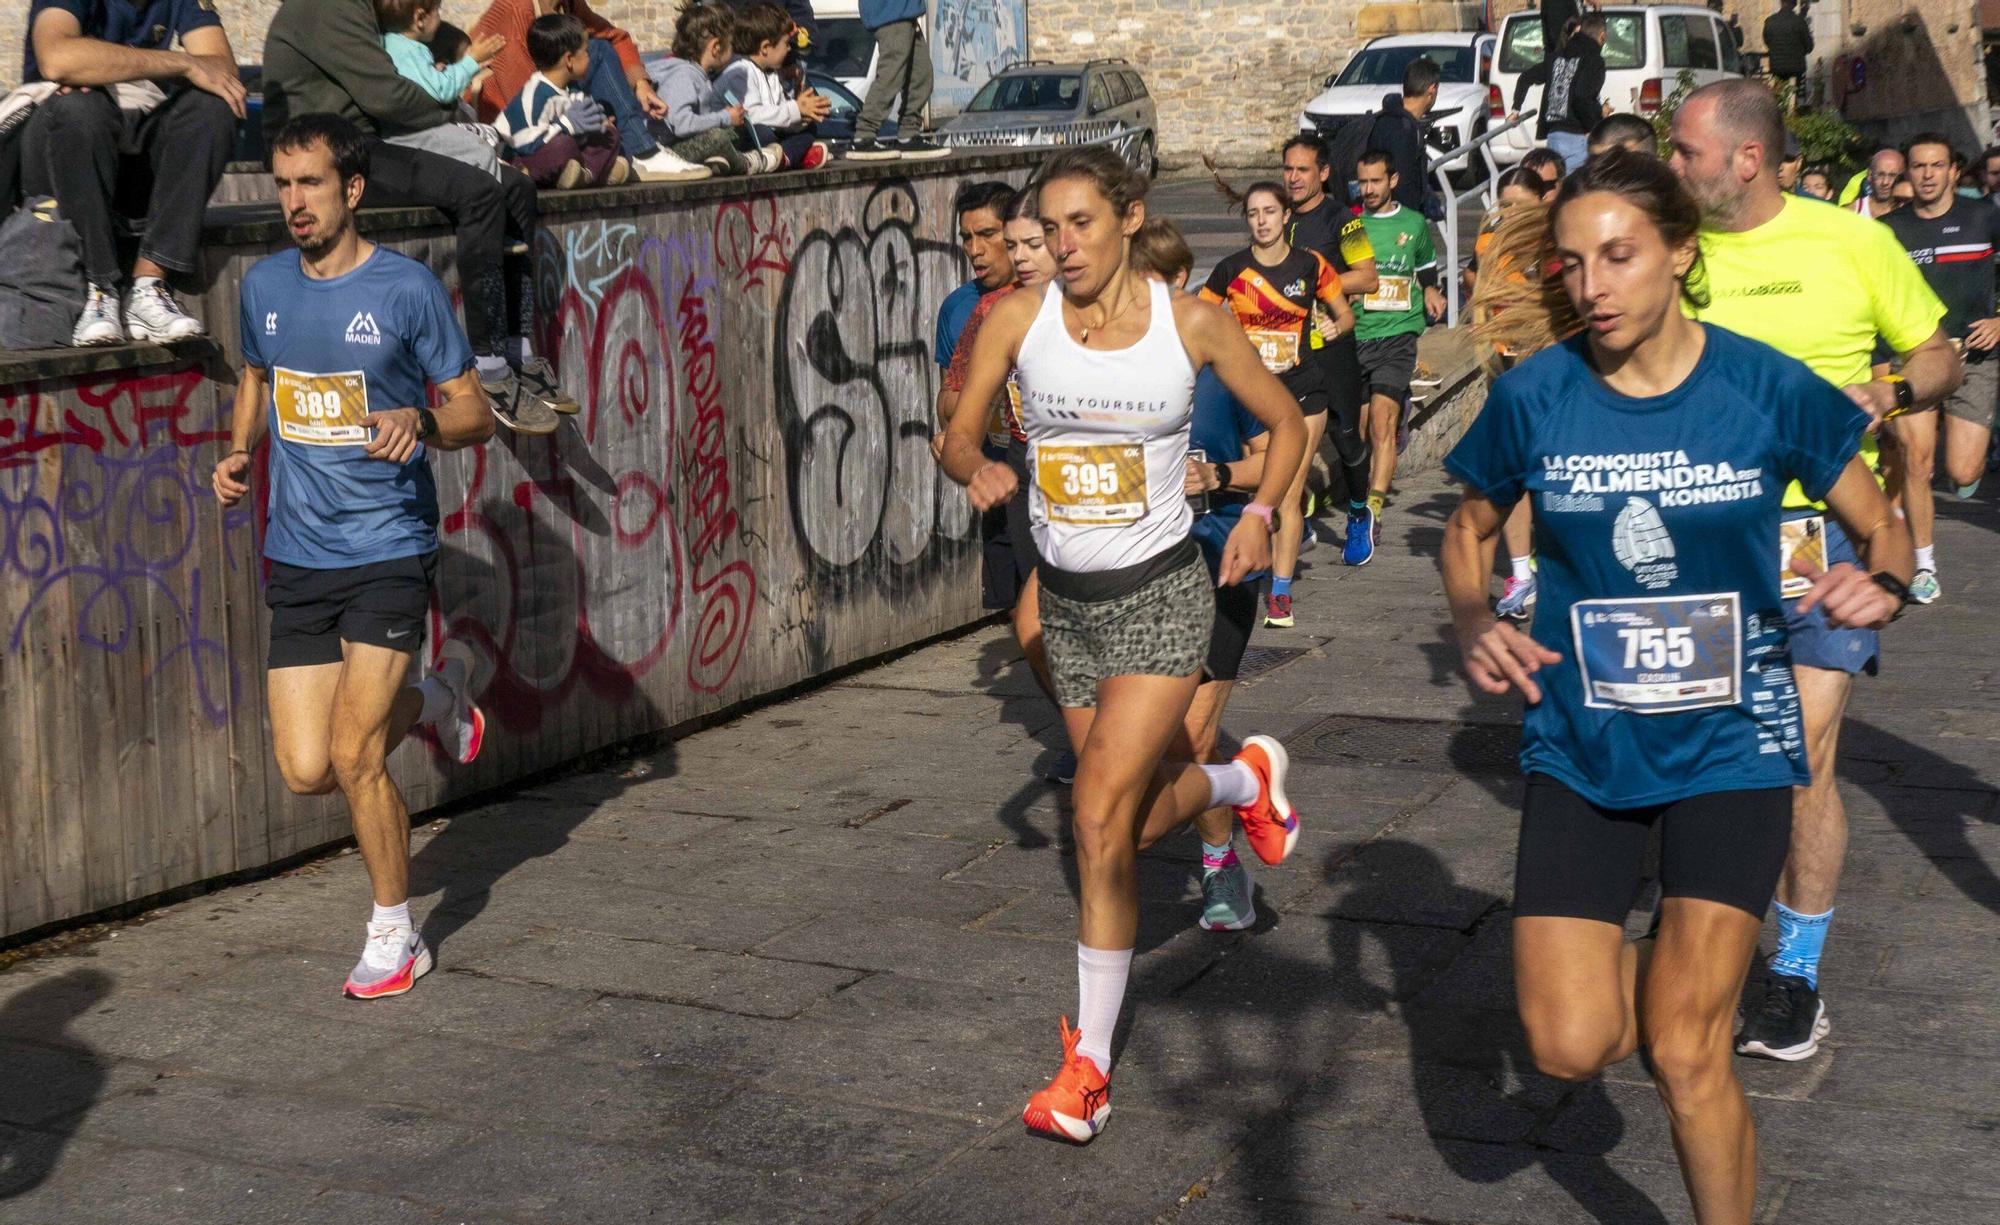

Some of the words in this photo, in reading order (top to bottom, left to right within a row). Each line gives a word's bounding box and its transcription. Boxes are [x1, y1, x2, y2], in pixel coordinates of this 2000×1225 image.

[345, 333, 381, 345] MADEN
[345, 378, 359, 387] 10K
[293, 390, 341, 418] 389
[1031, 390, 1066, 406] PUSH
[1077, 397, 1167, 412] YOURSELF
[1542, 454, 1566, 471] LA
[1566, 449, 1690, 473] CONQUISTA
[1060, 463, 1118, 495] 395
[1570, 461, 1737, 494] ALMENDRA
[1660, 480, 1764, 508] KONKISTA
[1709, 604, 1729, 618] 5K
[1617, 626, 1696, 670] 755
